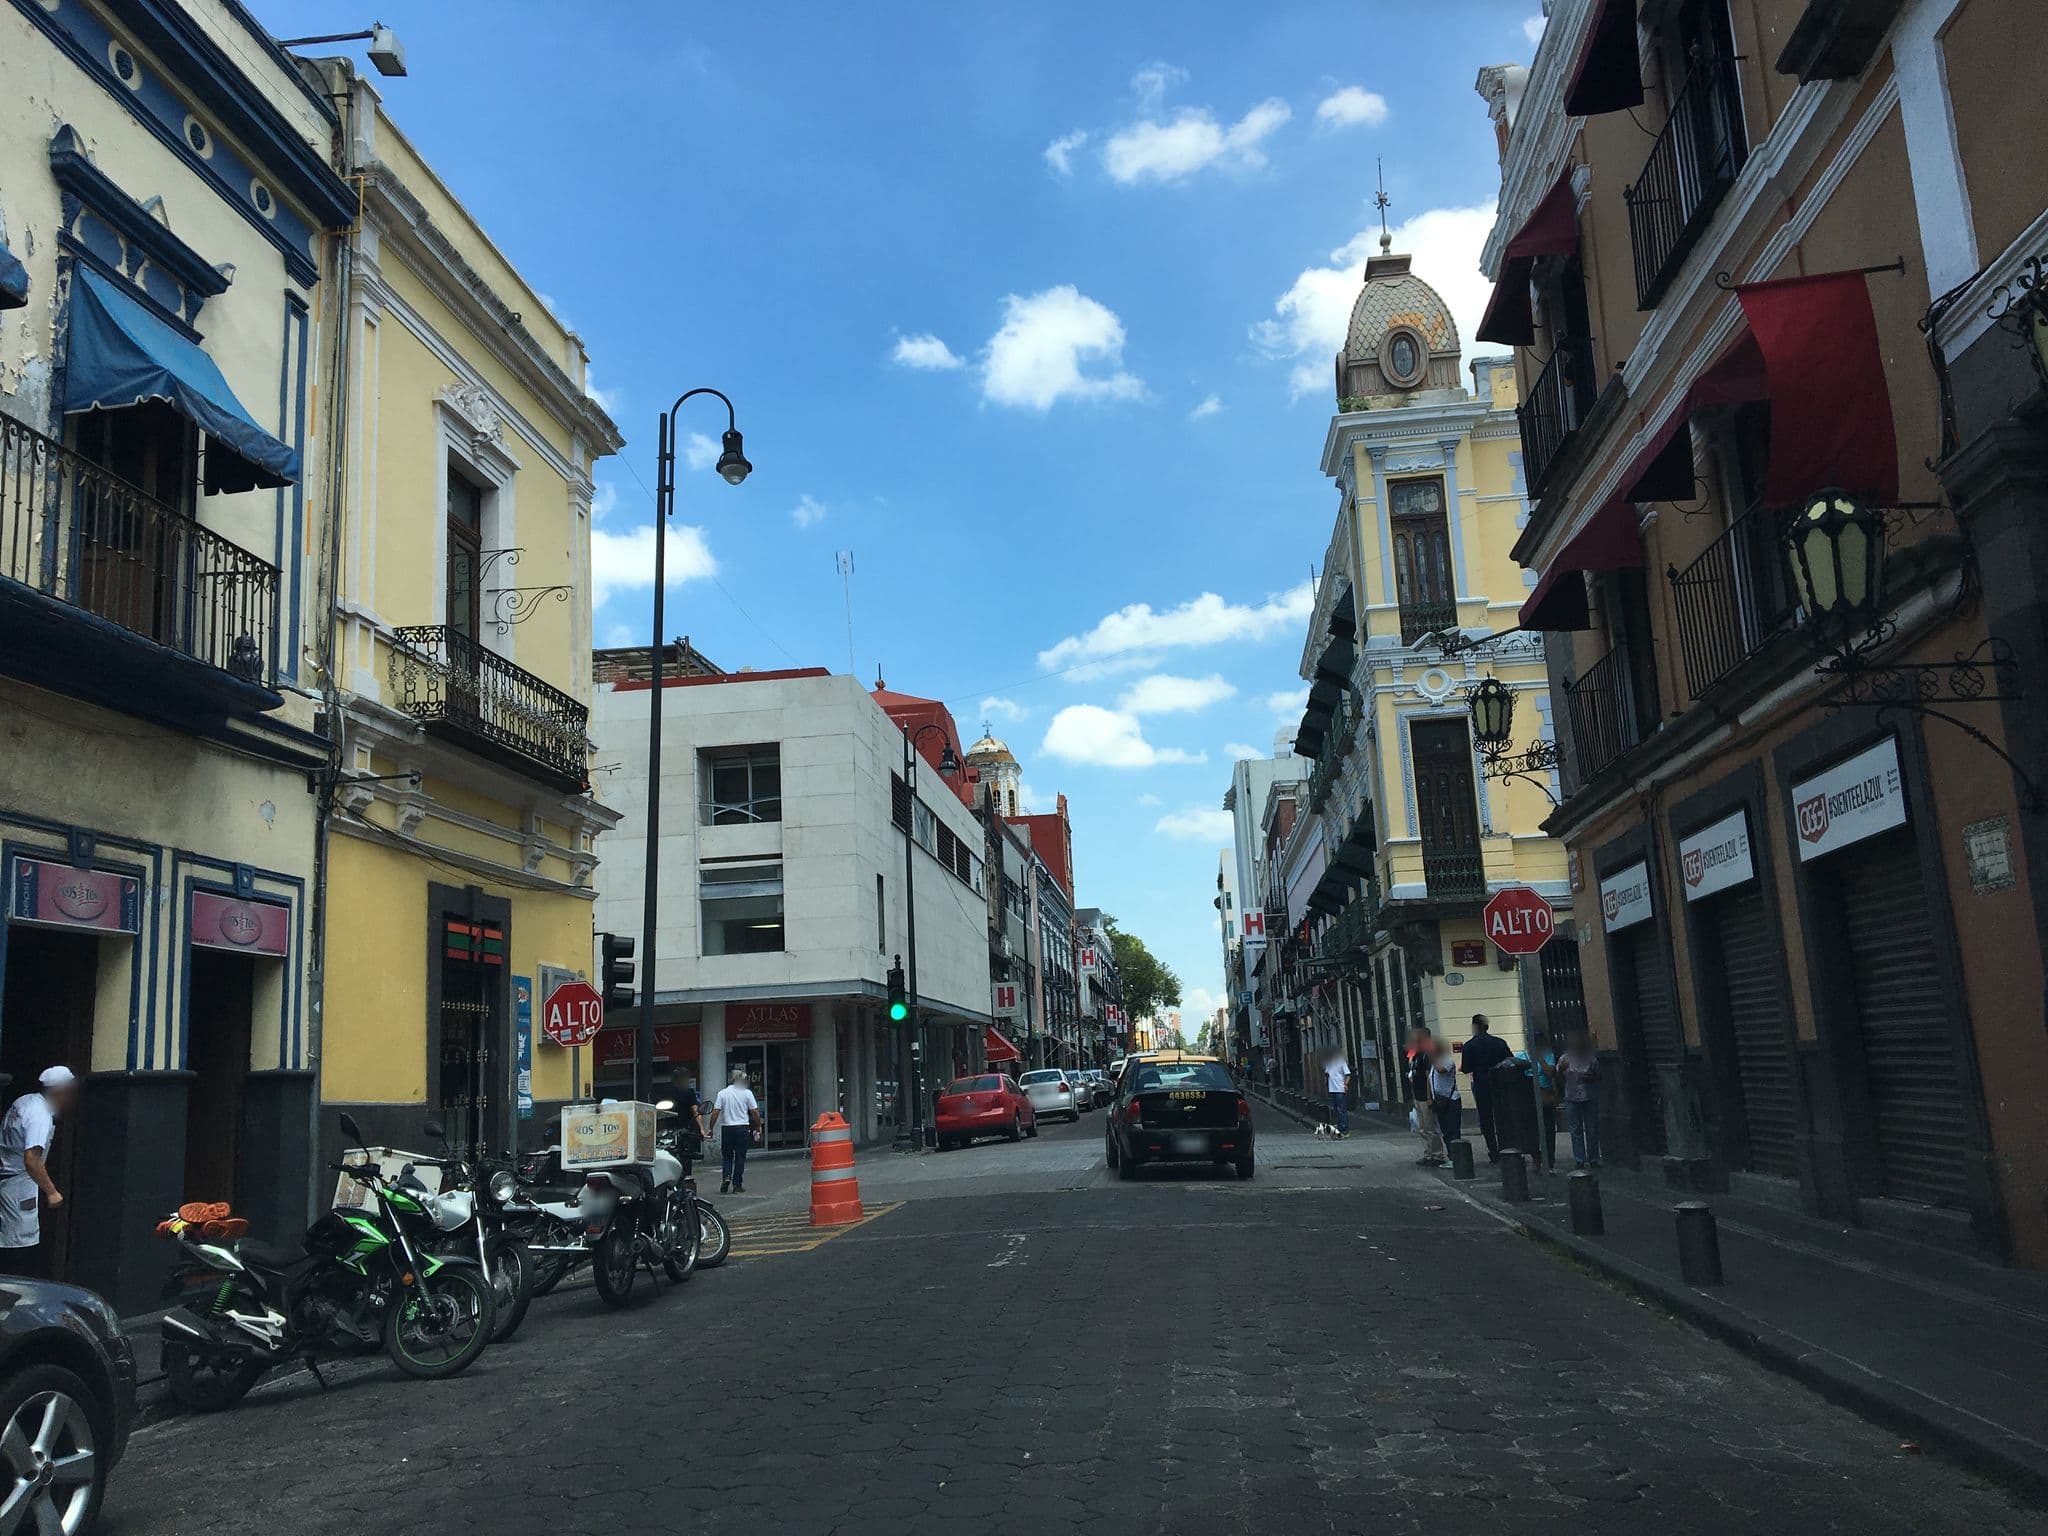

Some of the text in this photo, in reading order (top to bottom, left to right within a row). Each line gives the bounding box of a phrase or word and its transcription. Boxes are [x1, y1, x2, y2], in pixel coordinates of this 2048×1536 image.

[1828, 775, 1884, 819] #SIENTEELAZUL
[1245, 912, 1264, 935] H
[1492, 908, 1549, 936] ALTO
[1081, 949, 1095, 966] H
[997, 986, 1015, 1008] H
[549, 1000, 601, 1028] ALTO
[745, 1006, 801, 1023] ATLAS
[613, 1031, 670, 1048] ATAS
